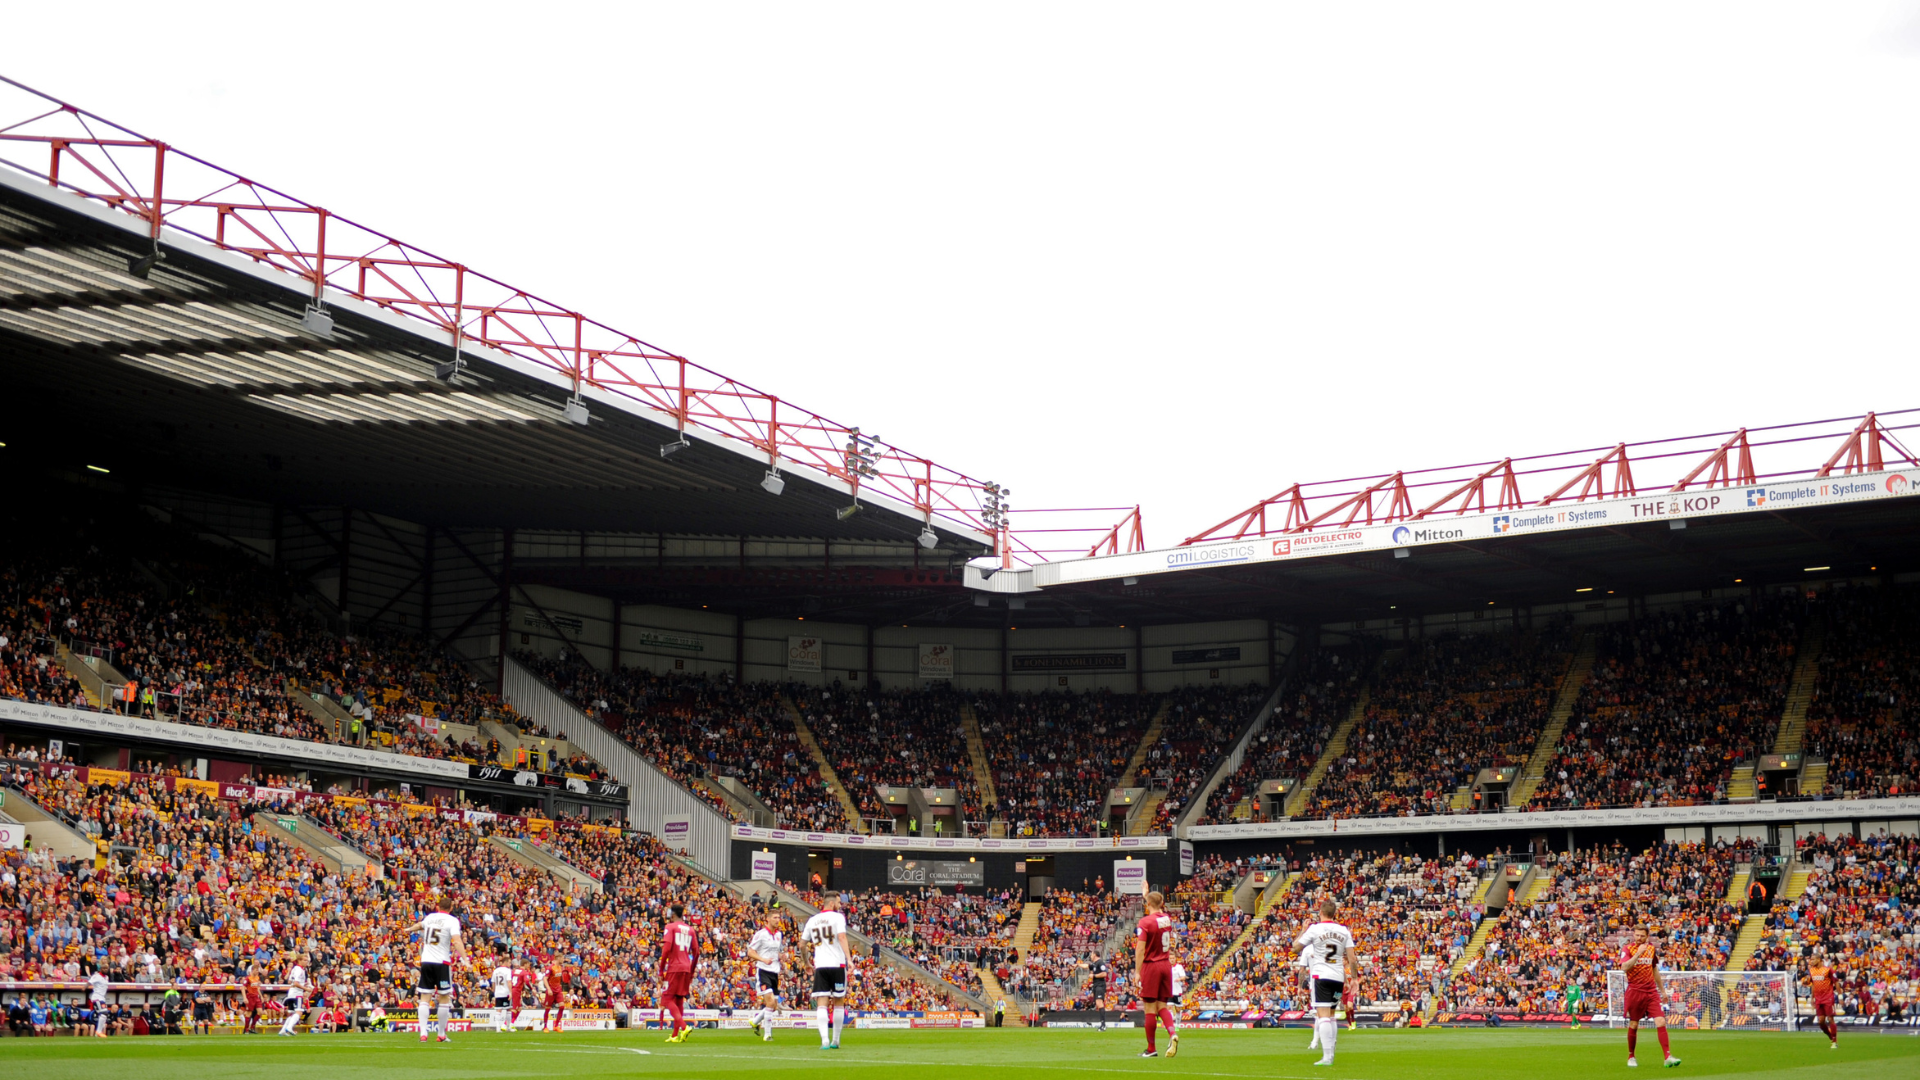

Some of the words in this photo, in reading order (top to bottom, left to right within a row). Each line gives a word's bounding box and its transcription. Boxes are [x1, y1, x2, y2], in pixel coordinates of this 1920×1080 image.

[1769, 488, 1816, 502] Complete
[1820, 485, 1829, 496] IT
[1832, 481, 1876, 495] Systems
[1631, 502, 1664, 517] THE
[1684, 496, 1720, 511] KOP
[1513, 514, 1554, 528] Complete
[1557, 512, 1566, 523] IT
[1568, 510, 1607, 522] Systems
[1294, 532, 1362, 546] AUTOELECTRO
[1414, 528, 1463, 542] Mitton
[790, 647, 820, 660] Coral
[921, 654, 952, 666] Coral
[479, 767, 502, 780] 1911
[600, 784, 620, 796] 1911
[892, 866, 926, 881] Coral
[426, 927, 442, 946] 15
[675, 933, 692, 953] 44
[812, 926, 835, 946] 34
[1162, 931, 1170, 953] 9
[1325, 944, 1337, 964] 2
[496, 976, 504, 986] 12
[448, 1023, 469, 1032] BET
